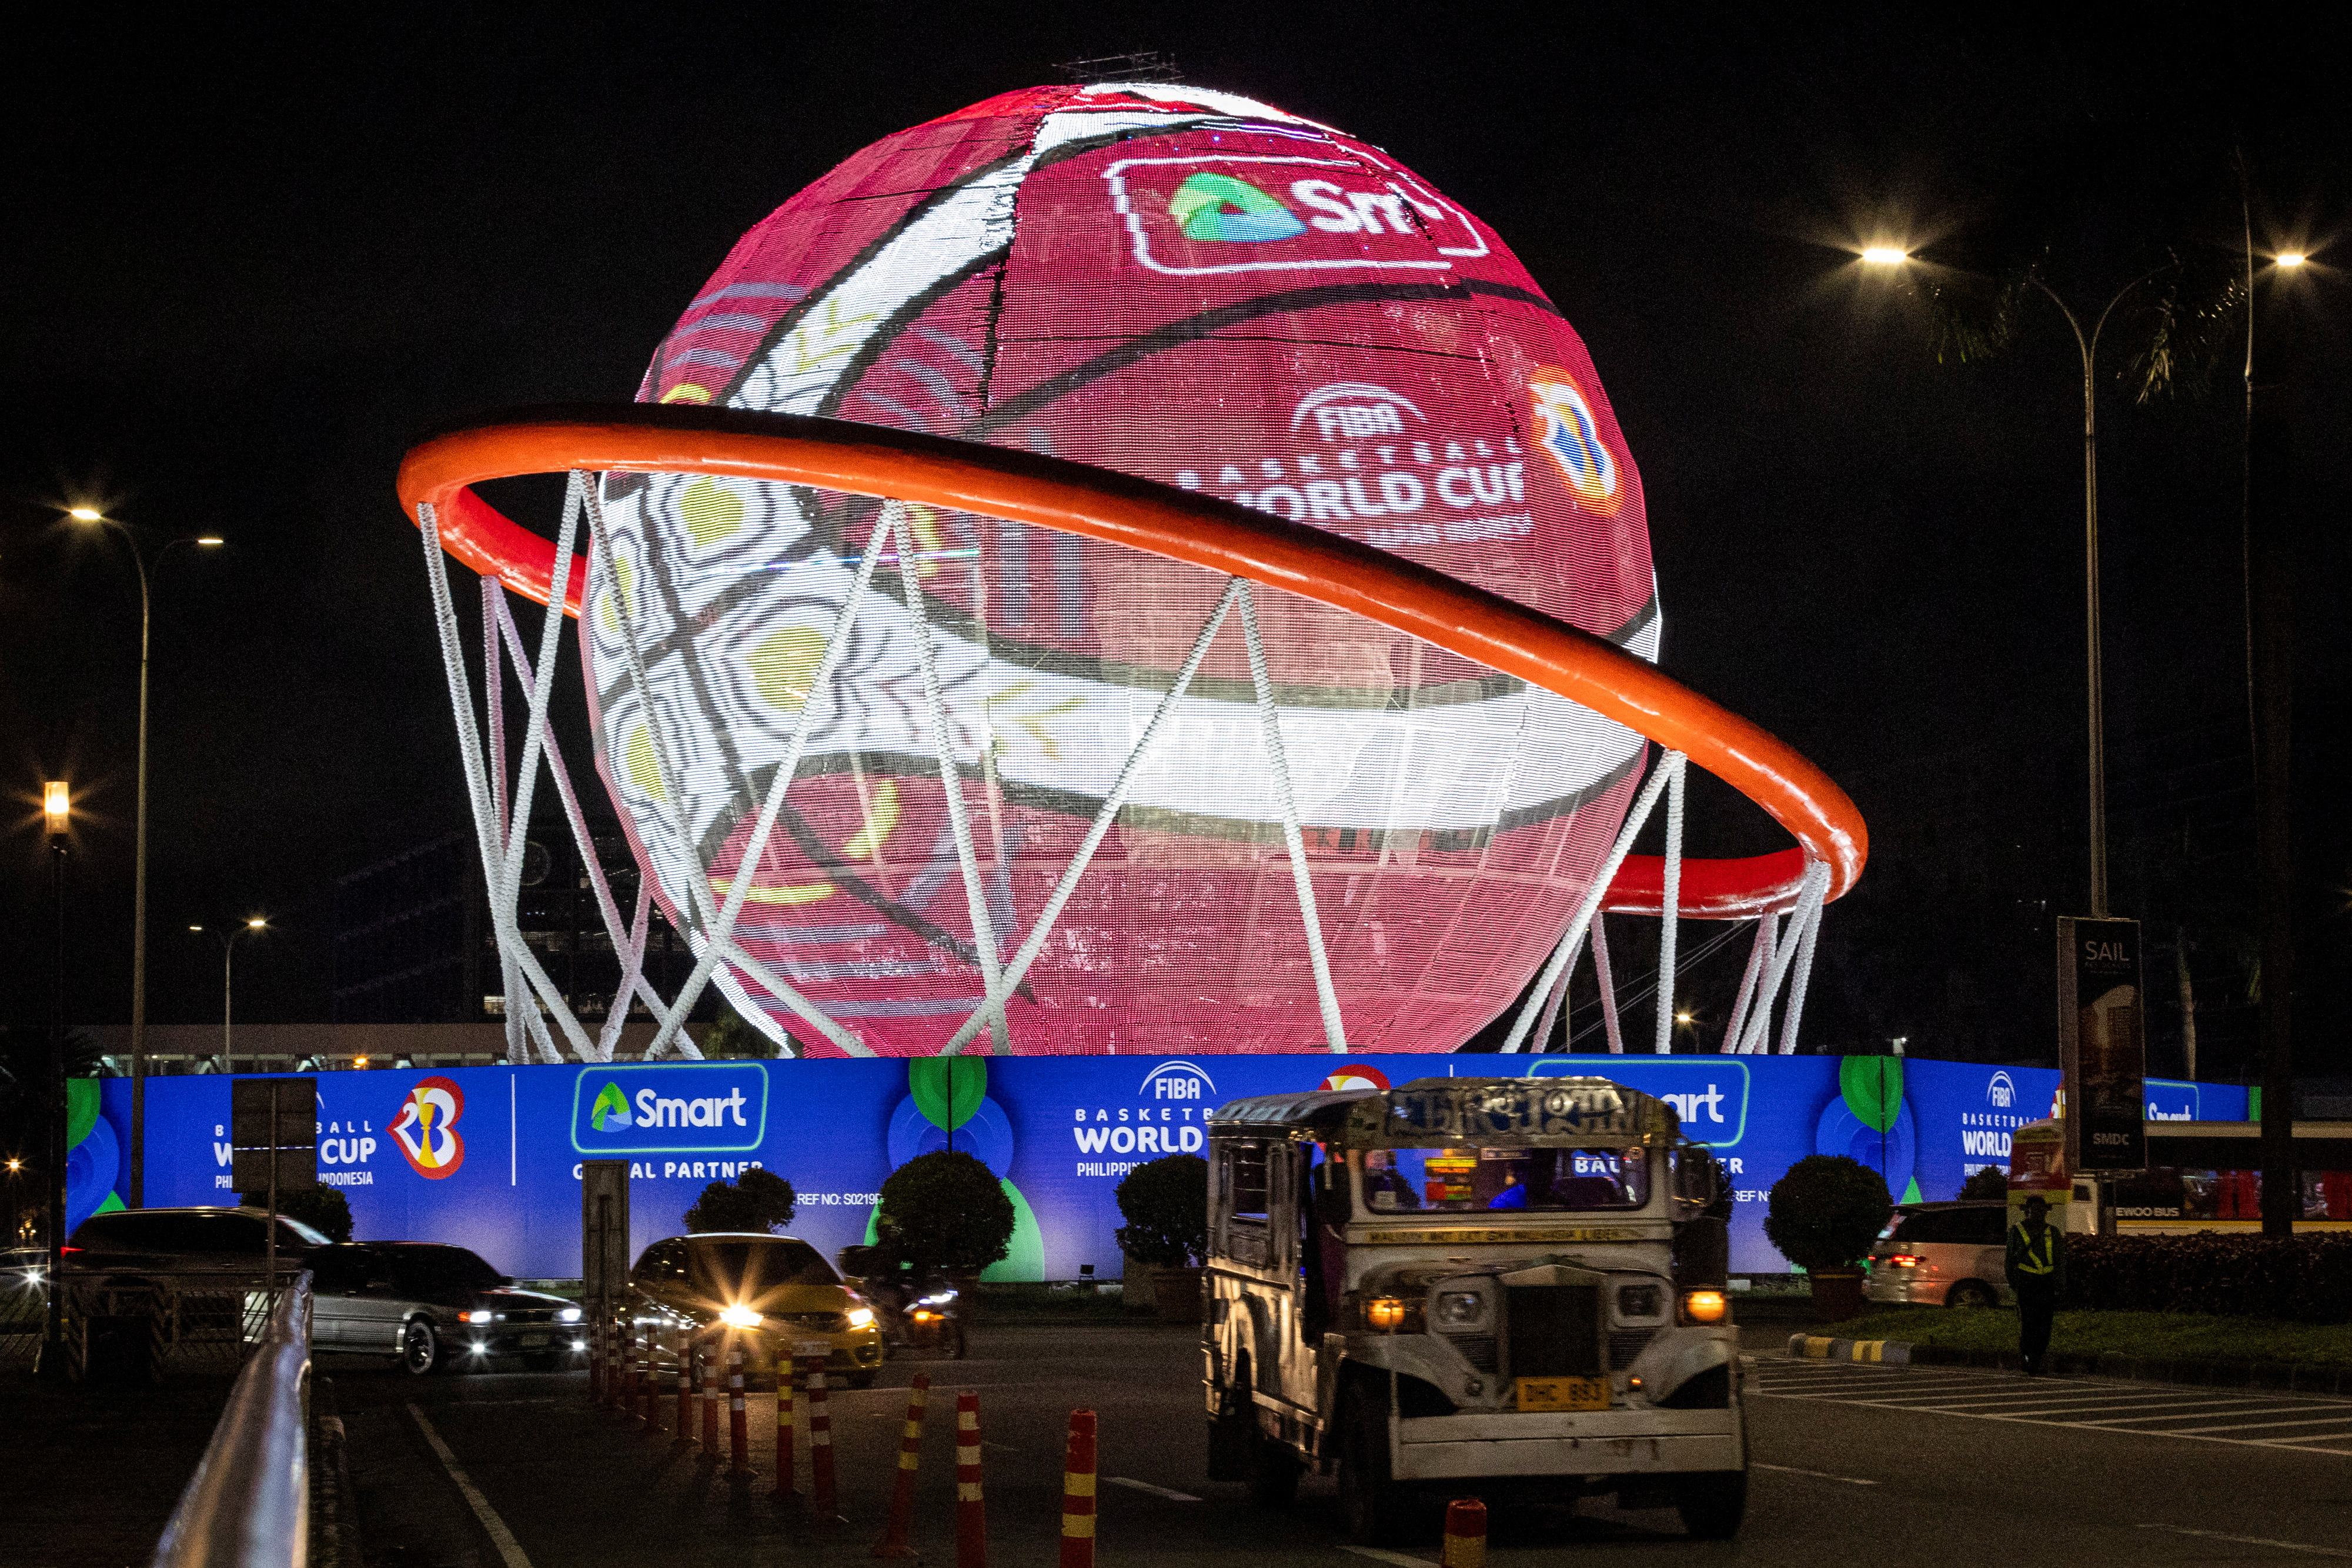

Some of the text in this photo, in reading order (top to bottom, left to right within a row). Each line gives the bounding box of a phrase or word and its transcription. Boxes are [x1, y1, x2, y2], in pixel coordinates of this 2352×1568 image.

[1316, 403, 1404, 440] FIBA
[2085, 940, 2130, 962] SAIL
[1154, 1078, 1201, 1099] FIBA
[1992, 1086, 2010, 1107] FIBA
[636, 1087, 746, 1127] Smart
[1660, 1084, 1724, 1124] art
[1075, 1108, 1214, 1122] BASKETB
[1962, 1112, 2037, 1128] BASKETBA
[1074, 1126, 1203, 1154] WORLD
[1962, 1131, 2012, 1157] WORLD
[2092, 1132, 2130, 1146] SMDC
[320, 1137, 376, 1164] CUP
[1077, 1162, 1148, 1176] PHILIPPI
[797, 1193, 820, 1205] REF
[821, 1193, 841, 1205] NO:
[2116, 1207, 2180, 1216] EWOO BUS
